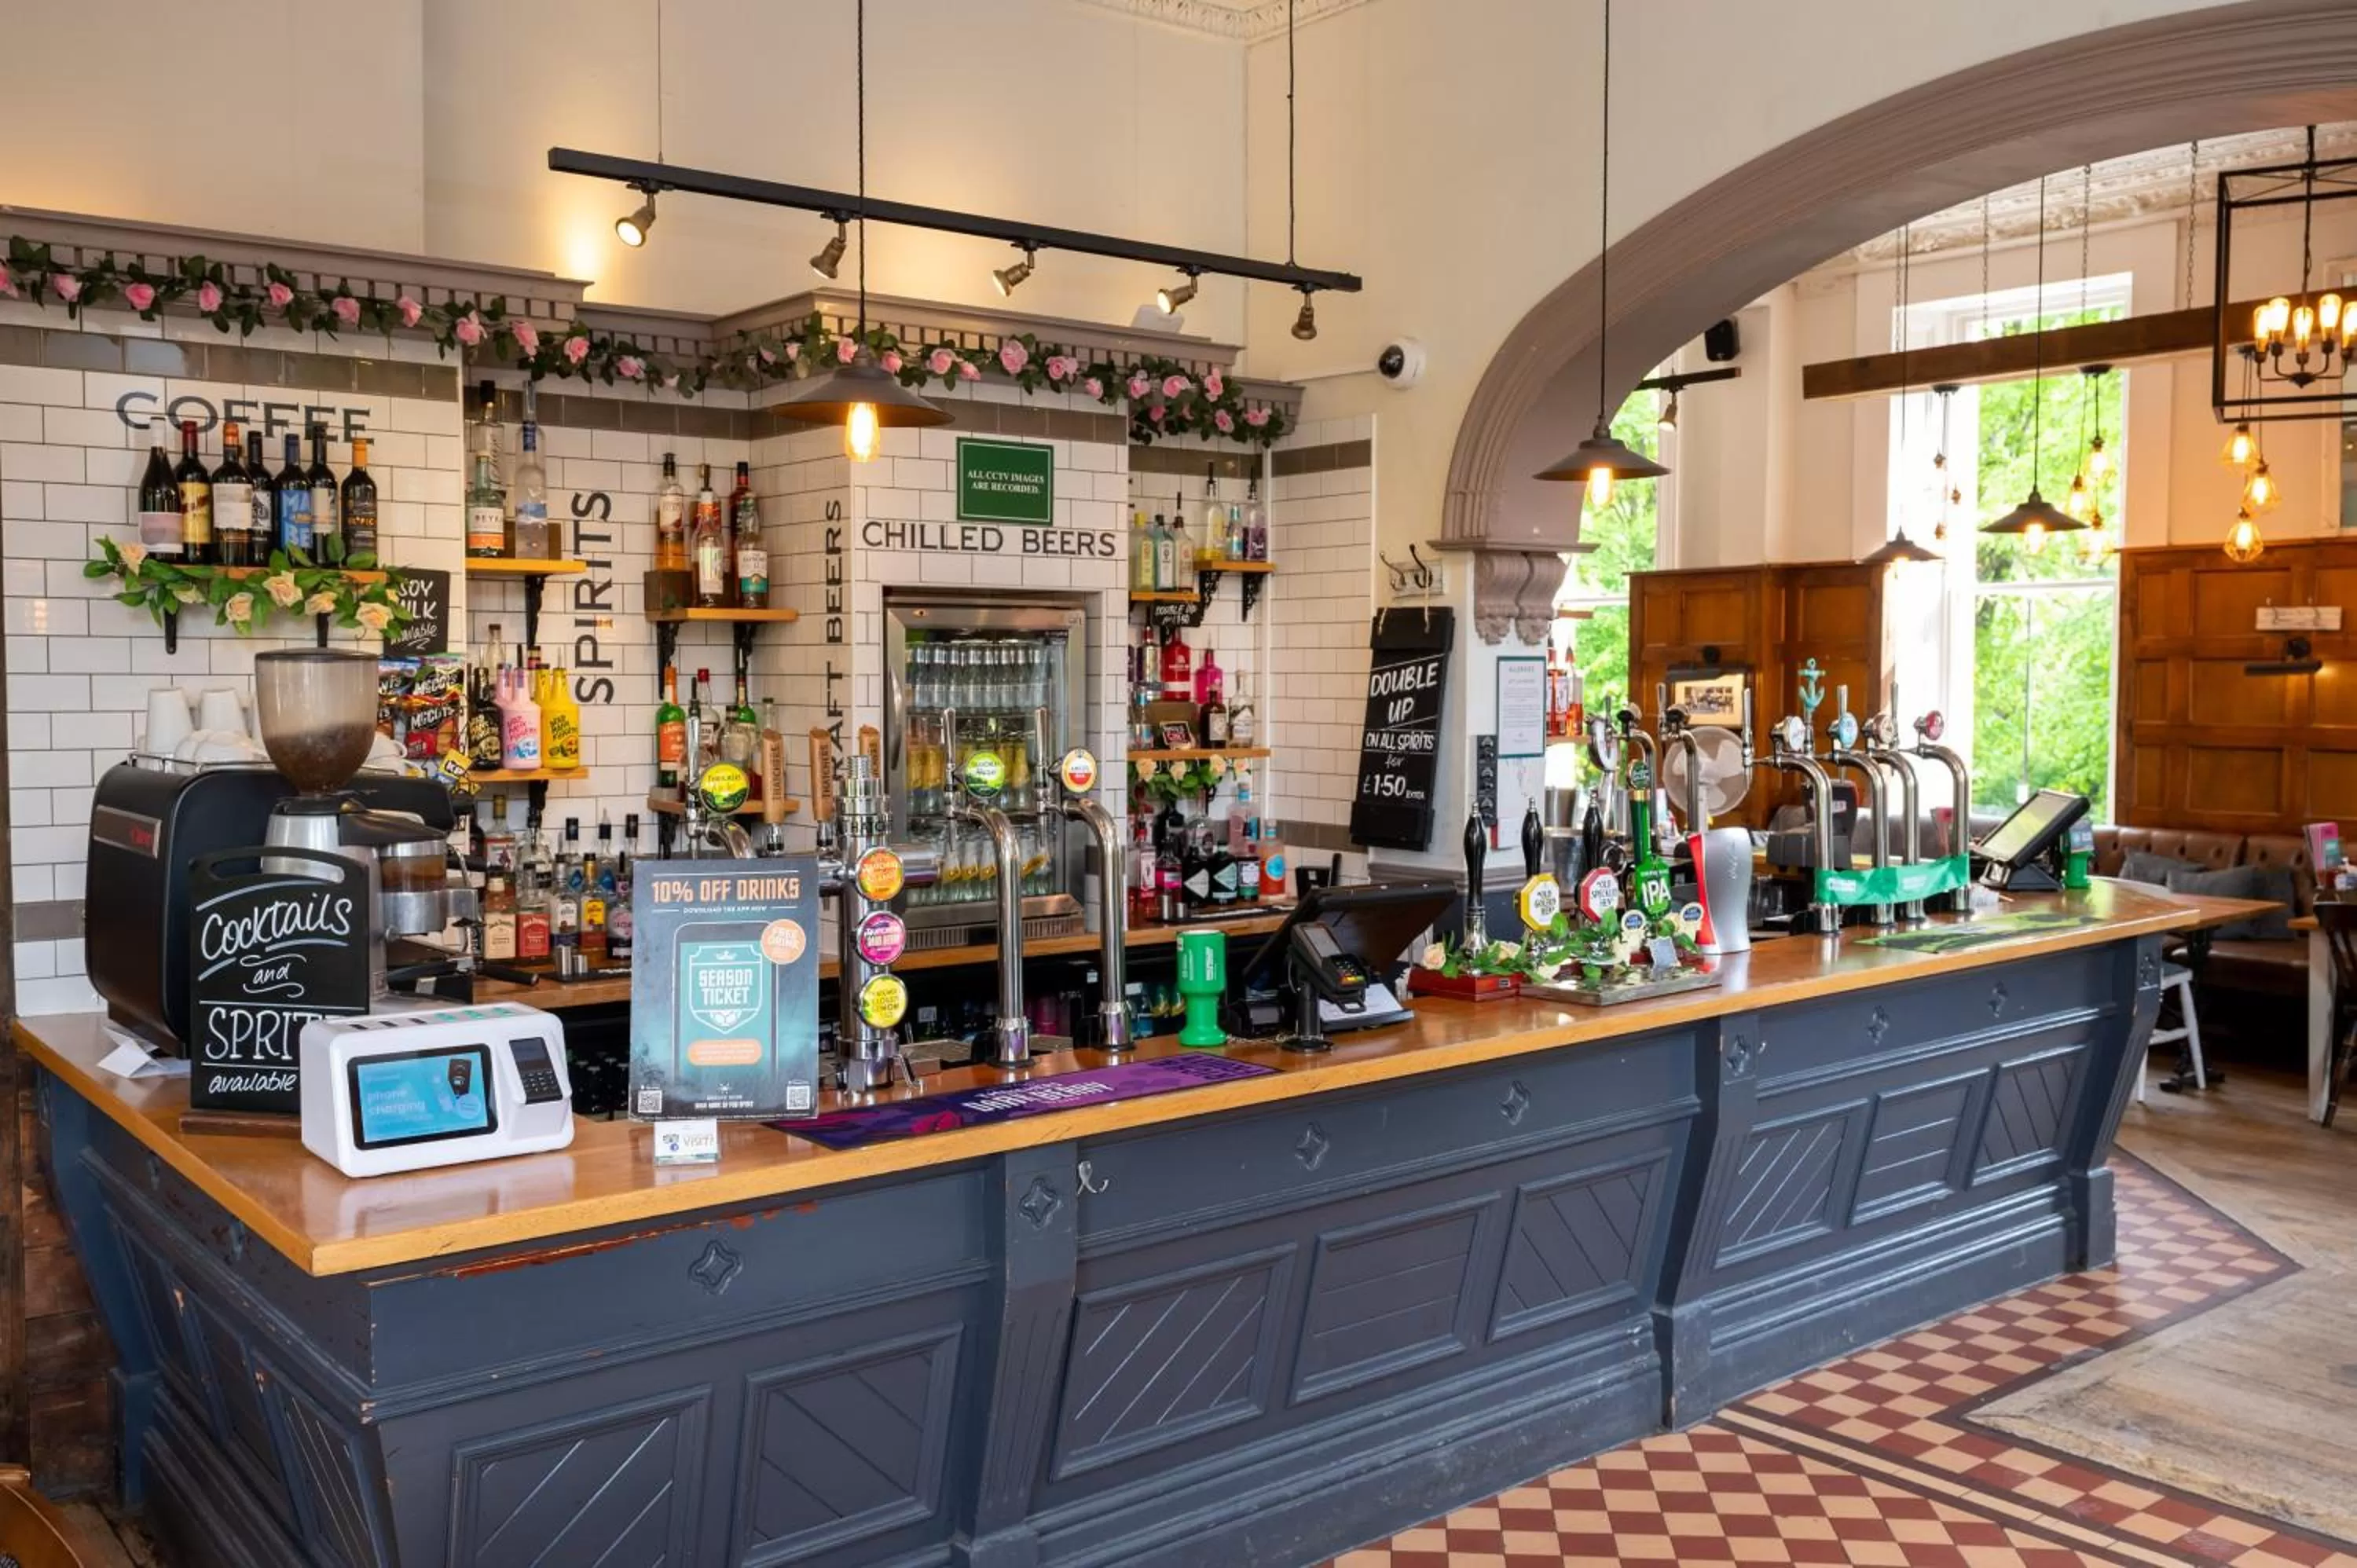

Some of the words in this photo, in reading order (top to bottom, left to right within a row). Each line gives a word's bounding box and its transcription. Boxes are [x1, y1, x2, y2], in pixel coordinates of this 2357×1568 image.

[116, 391, 375, 445] COFFEE
[967, 469, 984, 478] ALL
[985, 471, 1009, 480] CCTV
[1010, 473, 1045, 484] IMAGES
[970, 481, 988, 490] ARE
[862, 520, 1004, 552] CHILLED
[1021, 528, 1116, 557] BEERS
[826, 500, 844, 643] BEERS
[398, 577, 434, 598] SOY
[571, 491, 614, 704] SPIRITS
[400, 599, 438, 620] ILK
[1369, 662, 1439, 698] DOUBLE
[827, 661, 844, 781] RAFT
[1387, 697, 1415, 724] UP
[1365, 732, 1380, 747] ON
[1380, 732, 1396, 750] ALL
[1384, 753, 1405, 769] for
[651, 880, 693, 904] 10%
[700, 879, 731, 902] OFF
[736, 877, 801, 901] DRINKS
[1640, 877, 1672, 907] IPA
[201, 893, 354, 960] Cocktails
[253, 962, 290, 984] and
[698, 969, 753, 987] SEASON
[701, 987, 750, 1006] TICKET
[205, 1006, 324, 1061] SPRI
[208, 1071, 298, 1094] available
